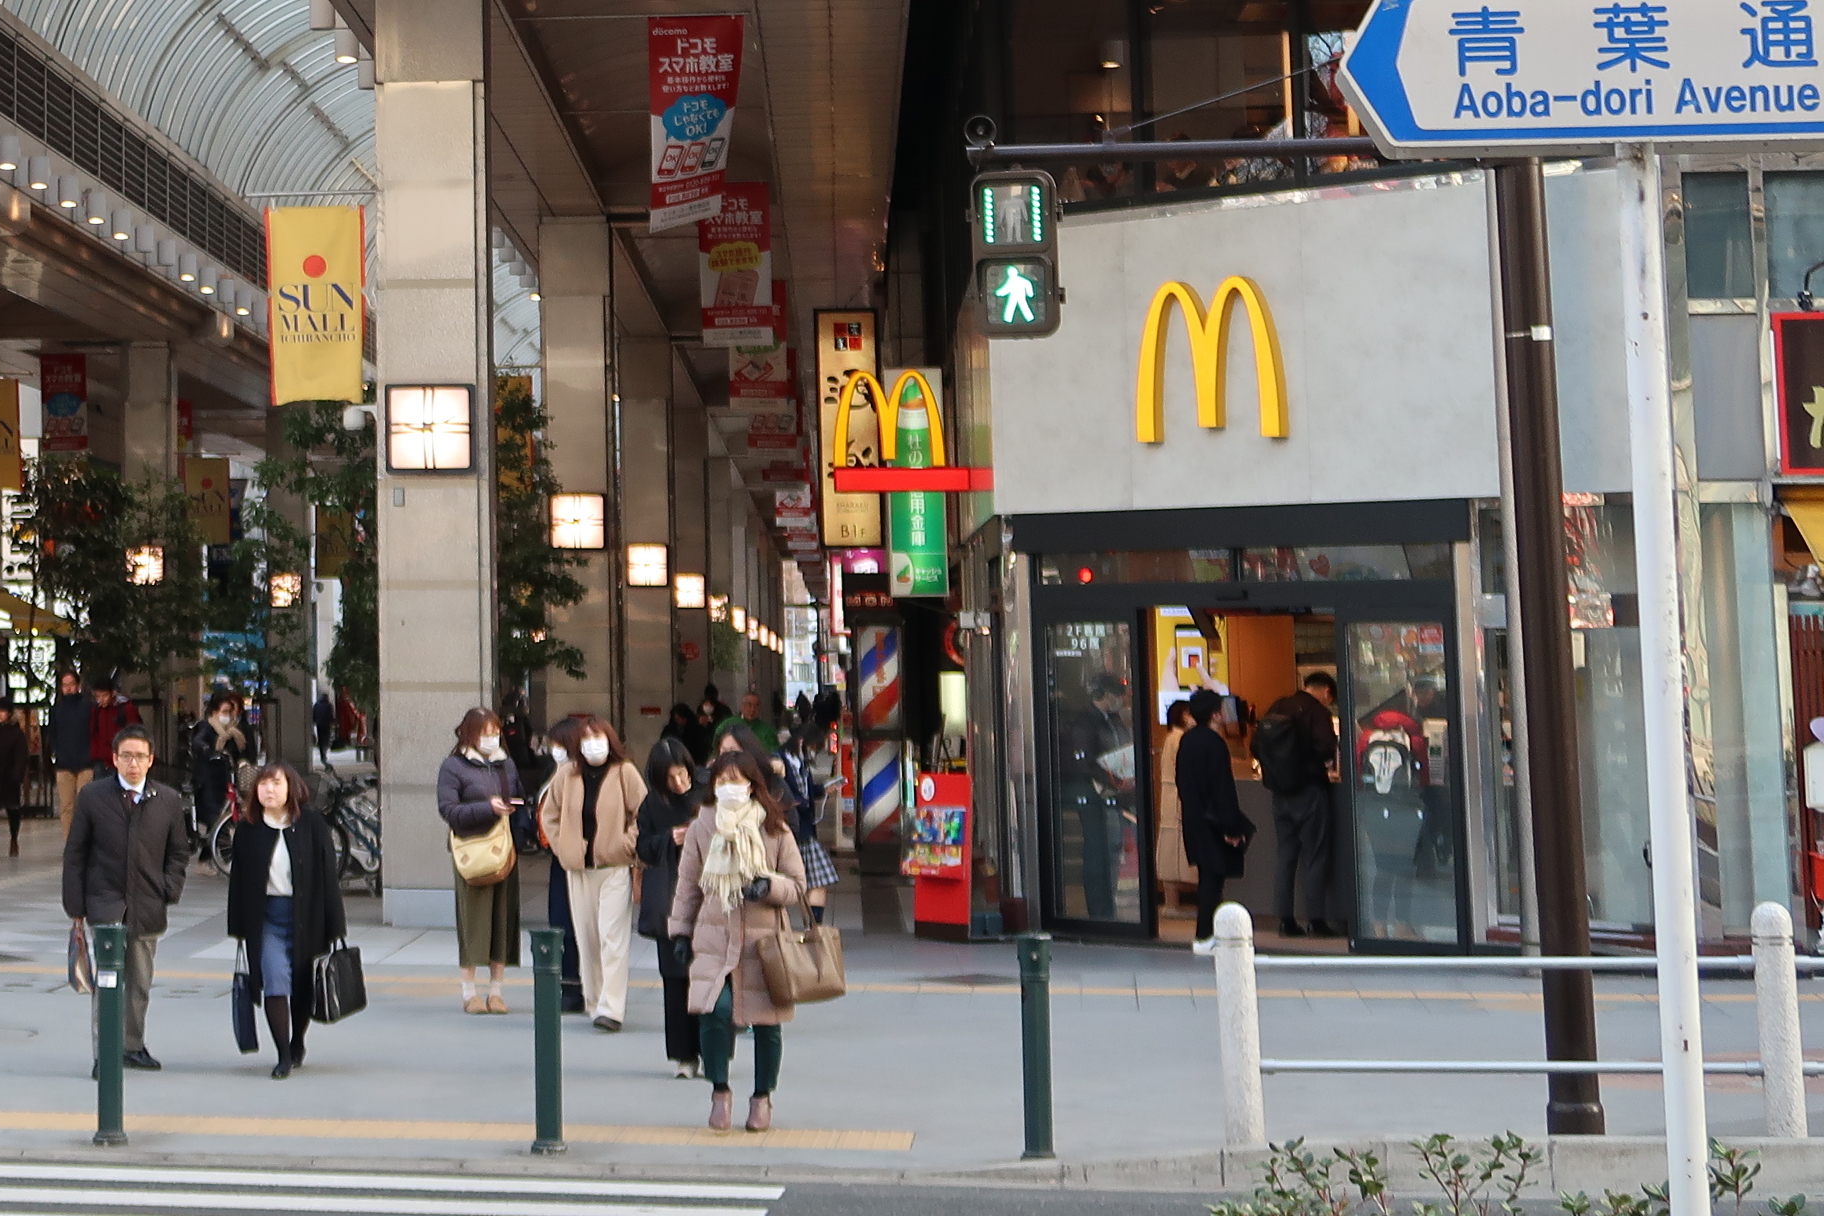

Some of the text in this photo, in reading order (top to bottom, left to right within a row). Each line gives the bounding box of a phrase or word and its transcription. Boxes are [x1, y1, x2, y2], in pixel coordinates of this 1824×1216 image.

[677, 37, 717, 55] ドコモ
[659, 53, 735, 74] スマホ教室
[683, 98, 709, 113] ドコモ
[1453, 77, 1821, 119] Aoba-dori Avenue
[674, 109, 720, 127] じゃなくても
[686, 123, 707, 137] OK!
[278, 282, 354, 313] SUN
[281, 312, 356, 333] MALL
[280, 332, 356, 344] ICHIBANCHO
[907, 434, 926, 547] 杜の用金庫
